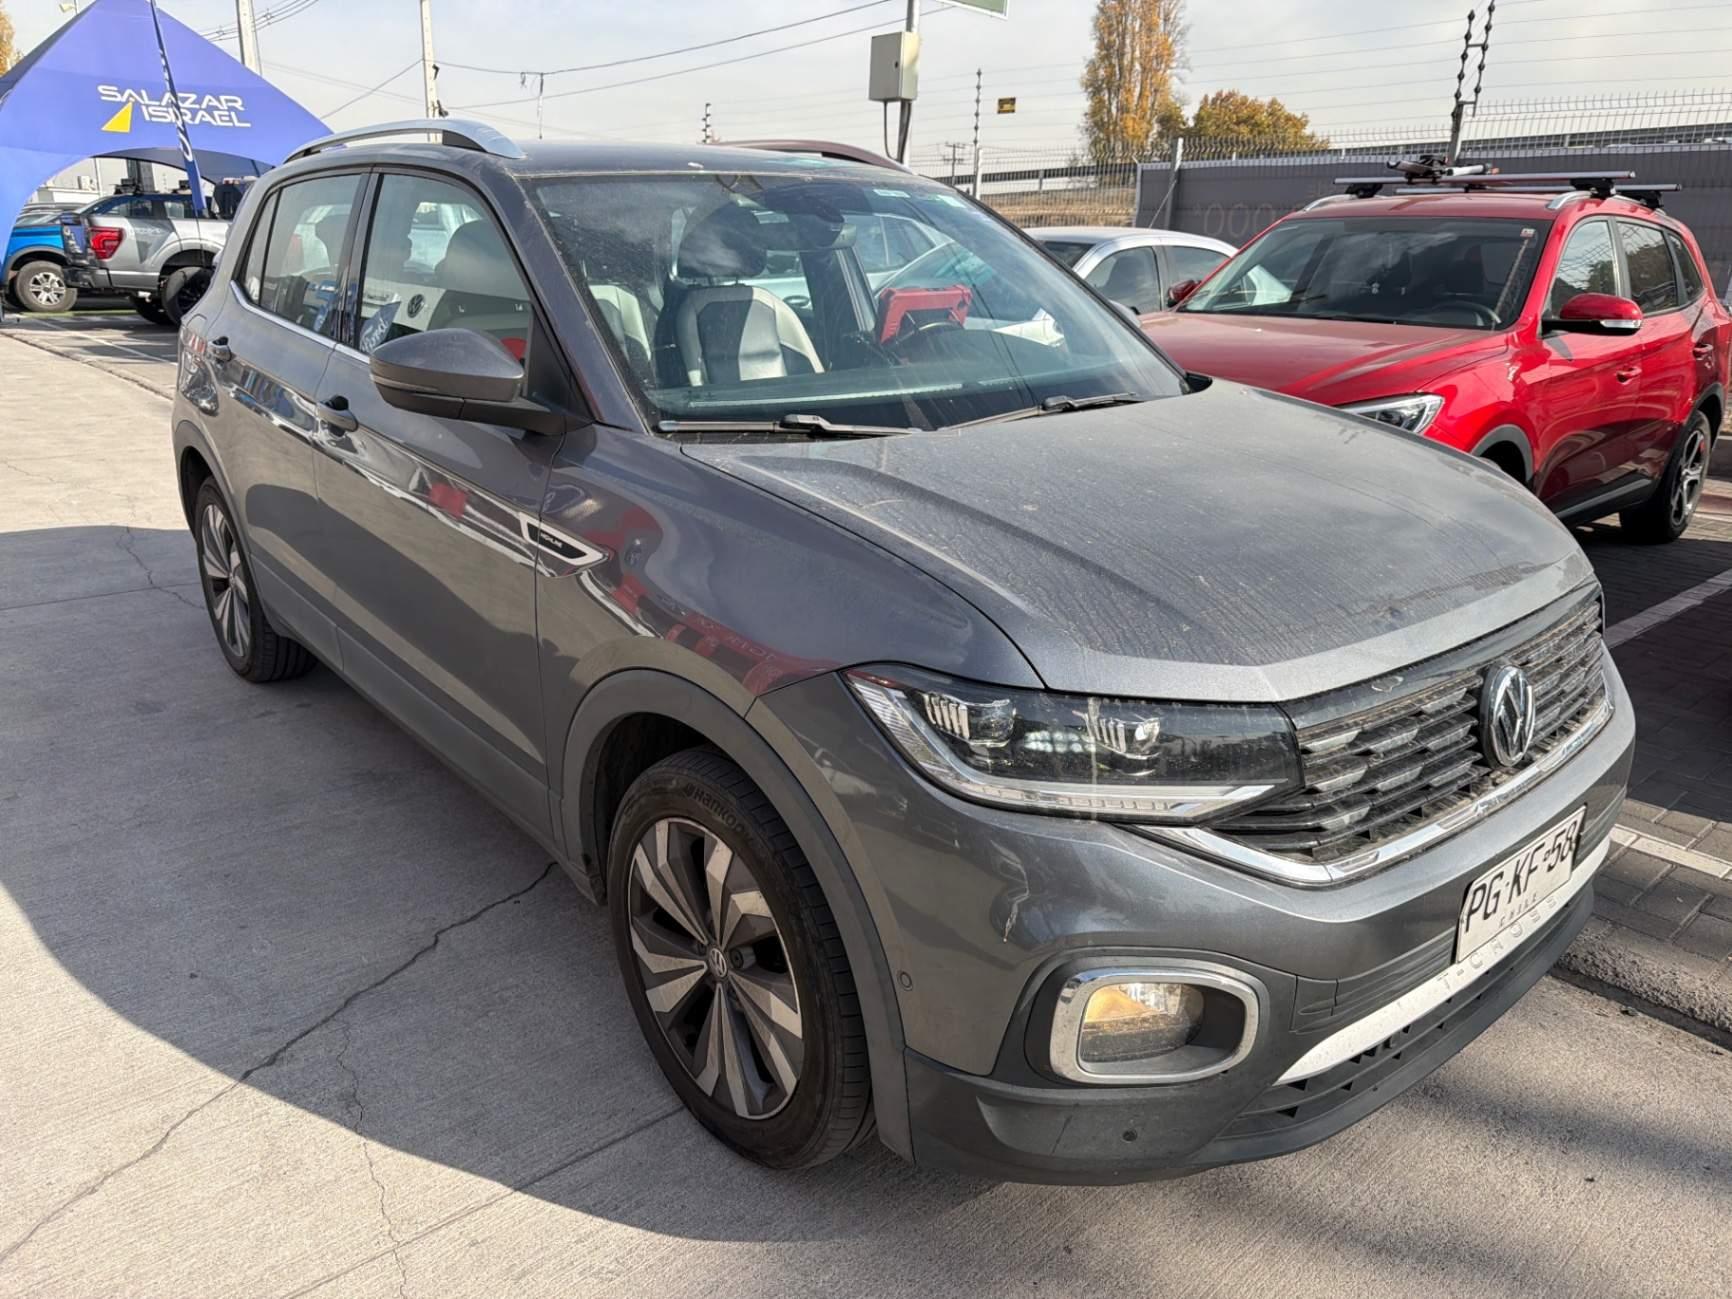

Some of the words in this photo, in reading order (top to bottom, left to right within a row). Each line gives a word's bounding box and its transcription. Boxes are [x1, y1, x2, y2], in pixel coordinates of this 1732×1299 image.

[97, 85, 245, 111] SALAZAR
[140, 105, 251, 128] ISRAEL
[1437, 895, 1558, 991] T-CROSS
